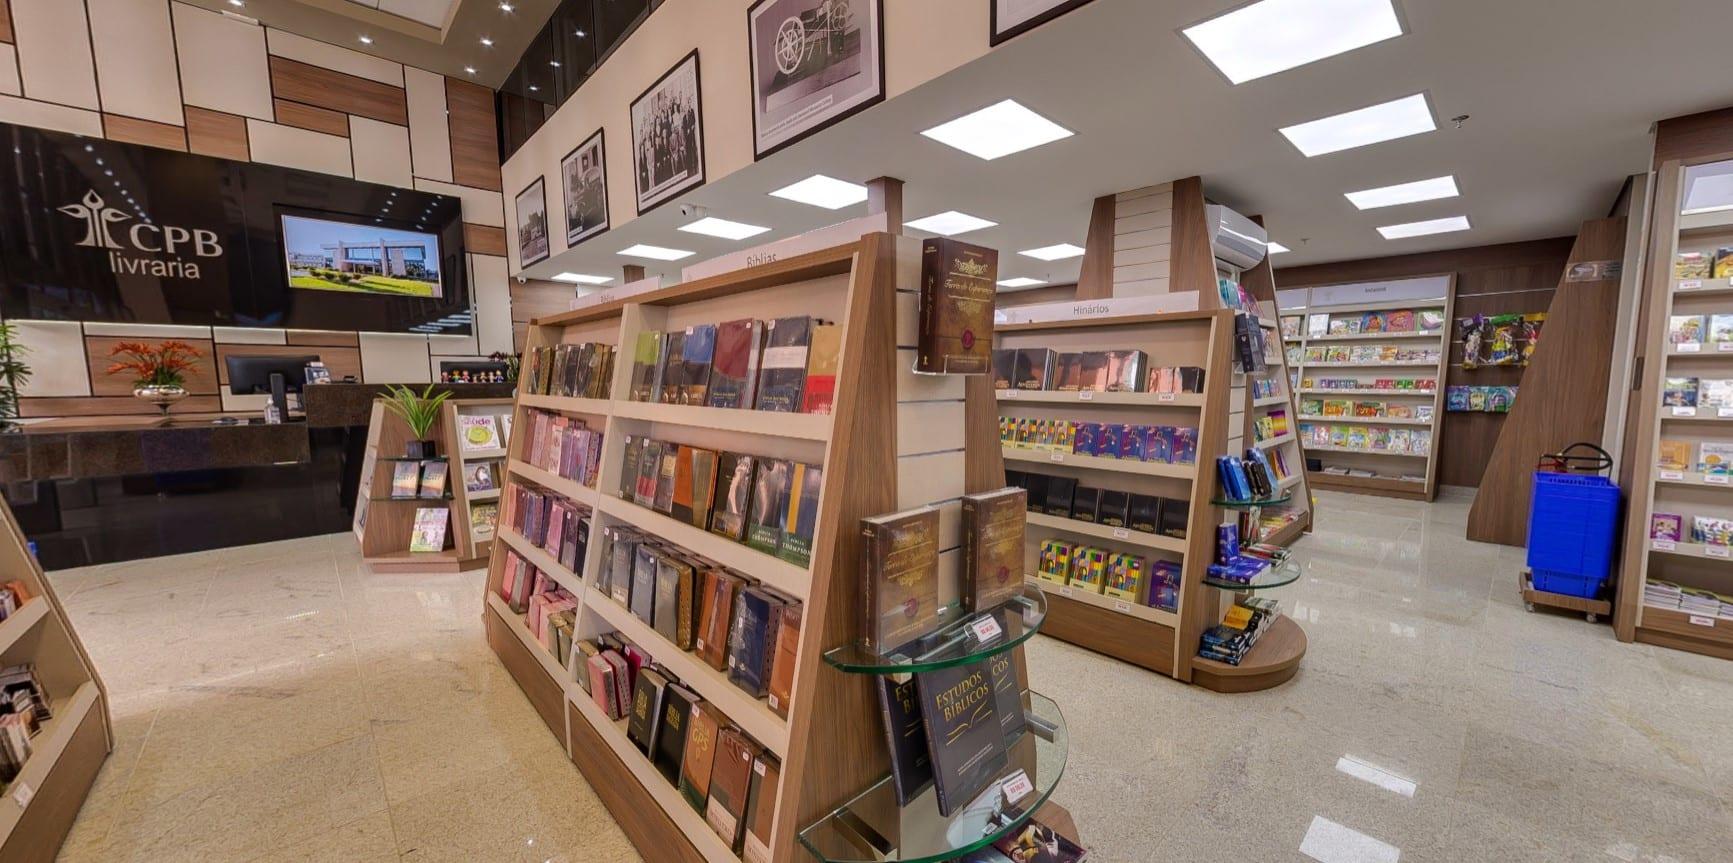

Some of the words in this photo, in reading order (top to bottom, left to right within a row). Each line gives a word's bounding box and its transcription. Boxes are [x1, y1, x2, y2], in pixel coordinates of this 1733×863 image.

[130, 223, 223, 257] CPB
[109, 251, 200, 279] livraria
[1073, 304, 1109, 315] Hinários
[936, 671, 982, 710] ESTUDOS
[944, 682, 989, 722] BÍBLICOS
